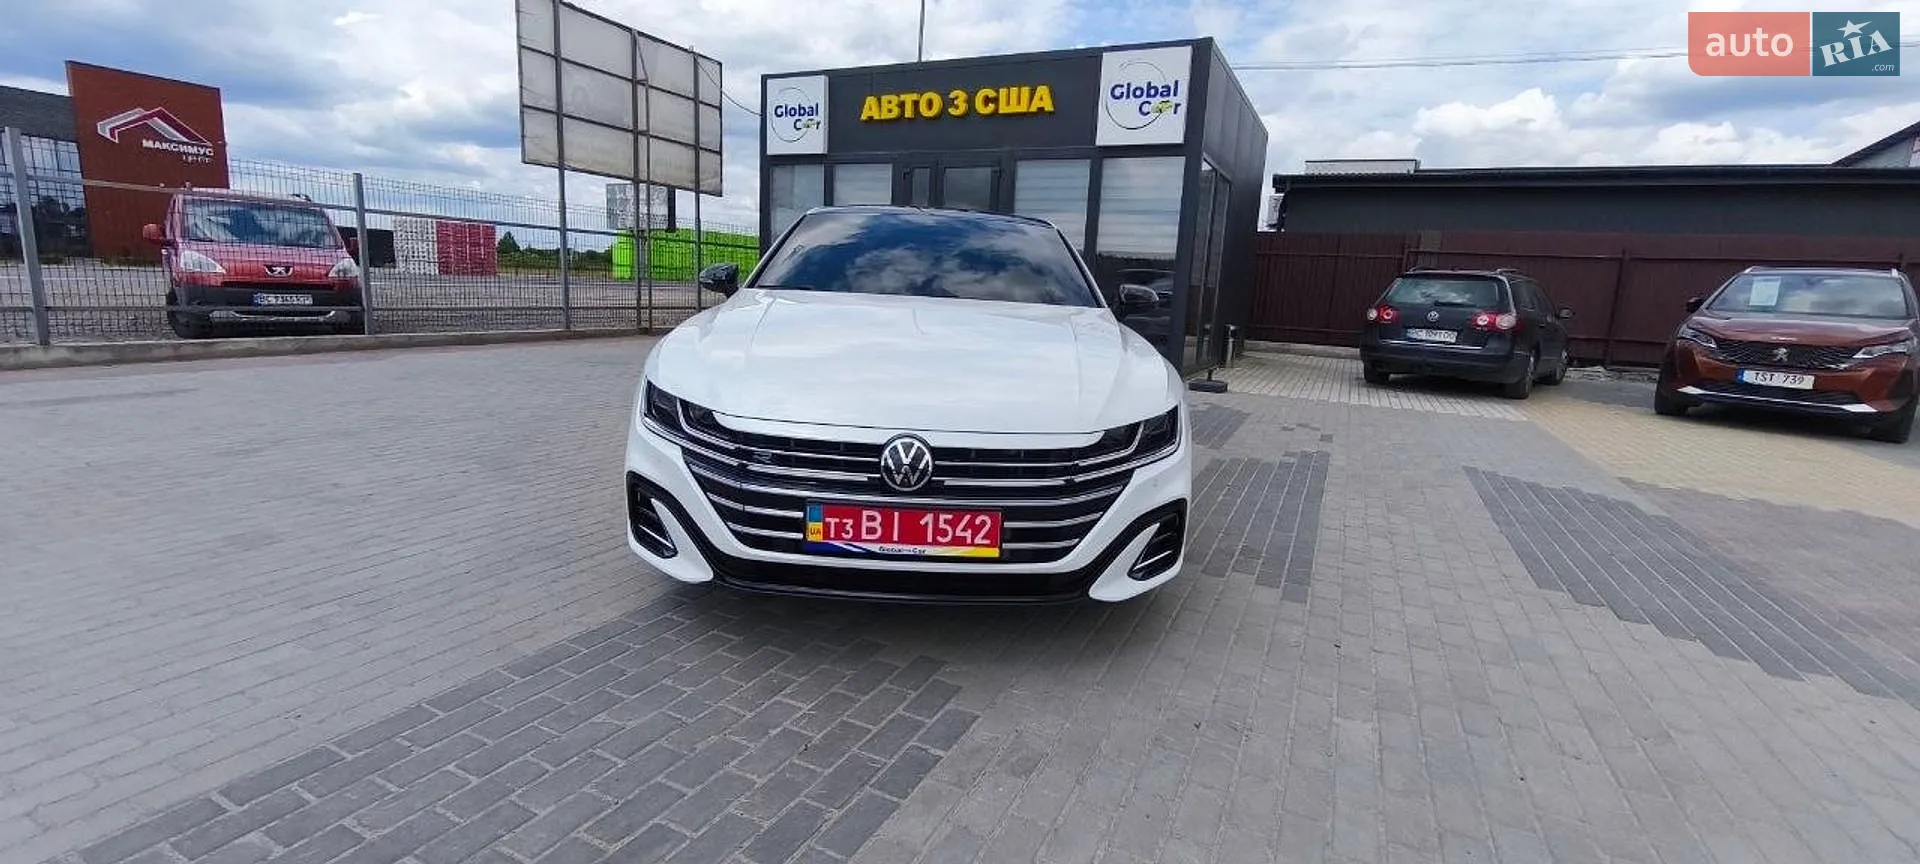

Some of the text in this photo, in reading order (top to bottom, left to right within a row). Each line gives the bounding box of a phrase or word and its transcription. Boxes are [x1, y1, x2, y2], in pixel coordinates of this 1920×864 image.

[1110, 80, 1179, 100] Global
[774, 102, 819, 118] Global
[860, 92, 943, 121] АВТО
[975, 85, 1055, 116] США
[142, 139, 214, 156] МАКСИМУС
[919, 512, 992, 545] 1542
